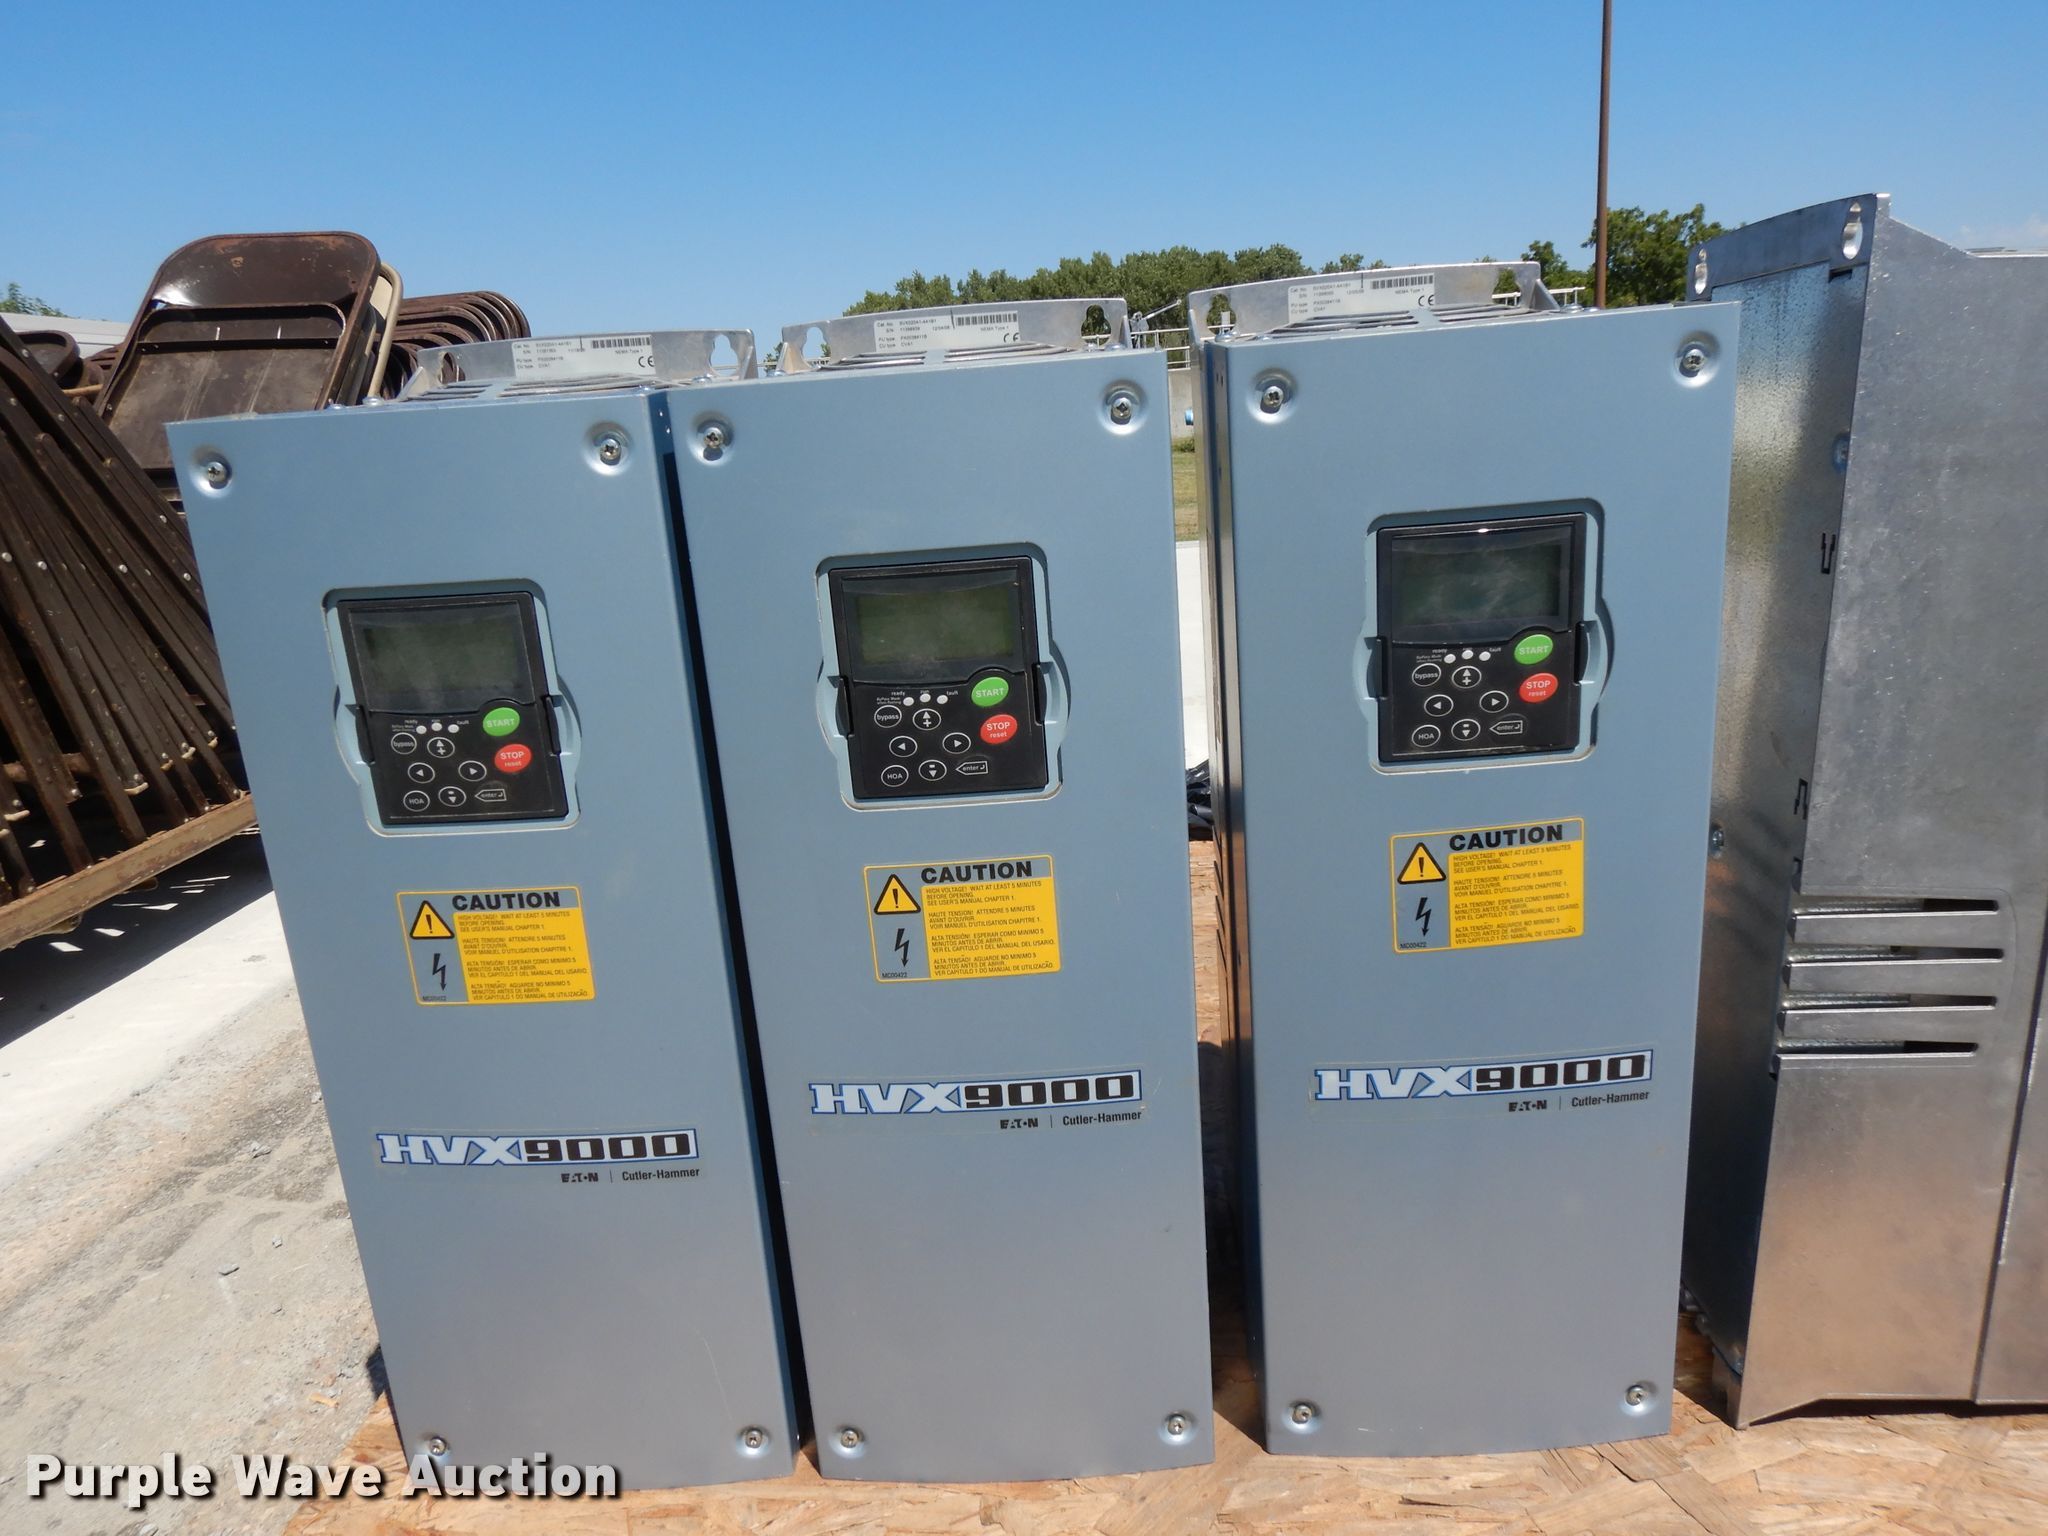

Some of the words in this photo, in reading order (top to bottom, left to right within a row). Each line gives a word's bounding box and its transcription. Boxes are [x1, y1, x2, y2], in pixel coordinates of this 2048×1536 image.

[1519, 645, 1548, 655] START
[1415, 672, 1438, 680] bypass
[1526, 681, 1551, 689] STOP
[975, 688, 1004, 698] START
[486, 718, 515, 728] START
[876, 713, 900, 722] bypass
[986, 721, 1010, 731] STOP
[501, 751, 524, 760] STOP
[1450, 824, 1563, 851] CAUTION
[921, 861, 1032, 884] CAUTION
[452, 892, 560, 911] CAUTION
[1314, 1054, 1646, 1100] HVX9000
[808, 1074, 1134, 1114] HVX9000
[1571, 1091, 1650, 1108] Cutler-Hammer
[1062, 1111, 1142, 1127] Cutler-Hammer
[376, 1132, 691, 1166] HVX9000
[622, 1167, 700, 1181] Cutler-Hammer
